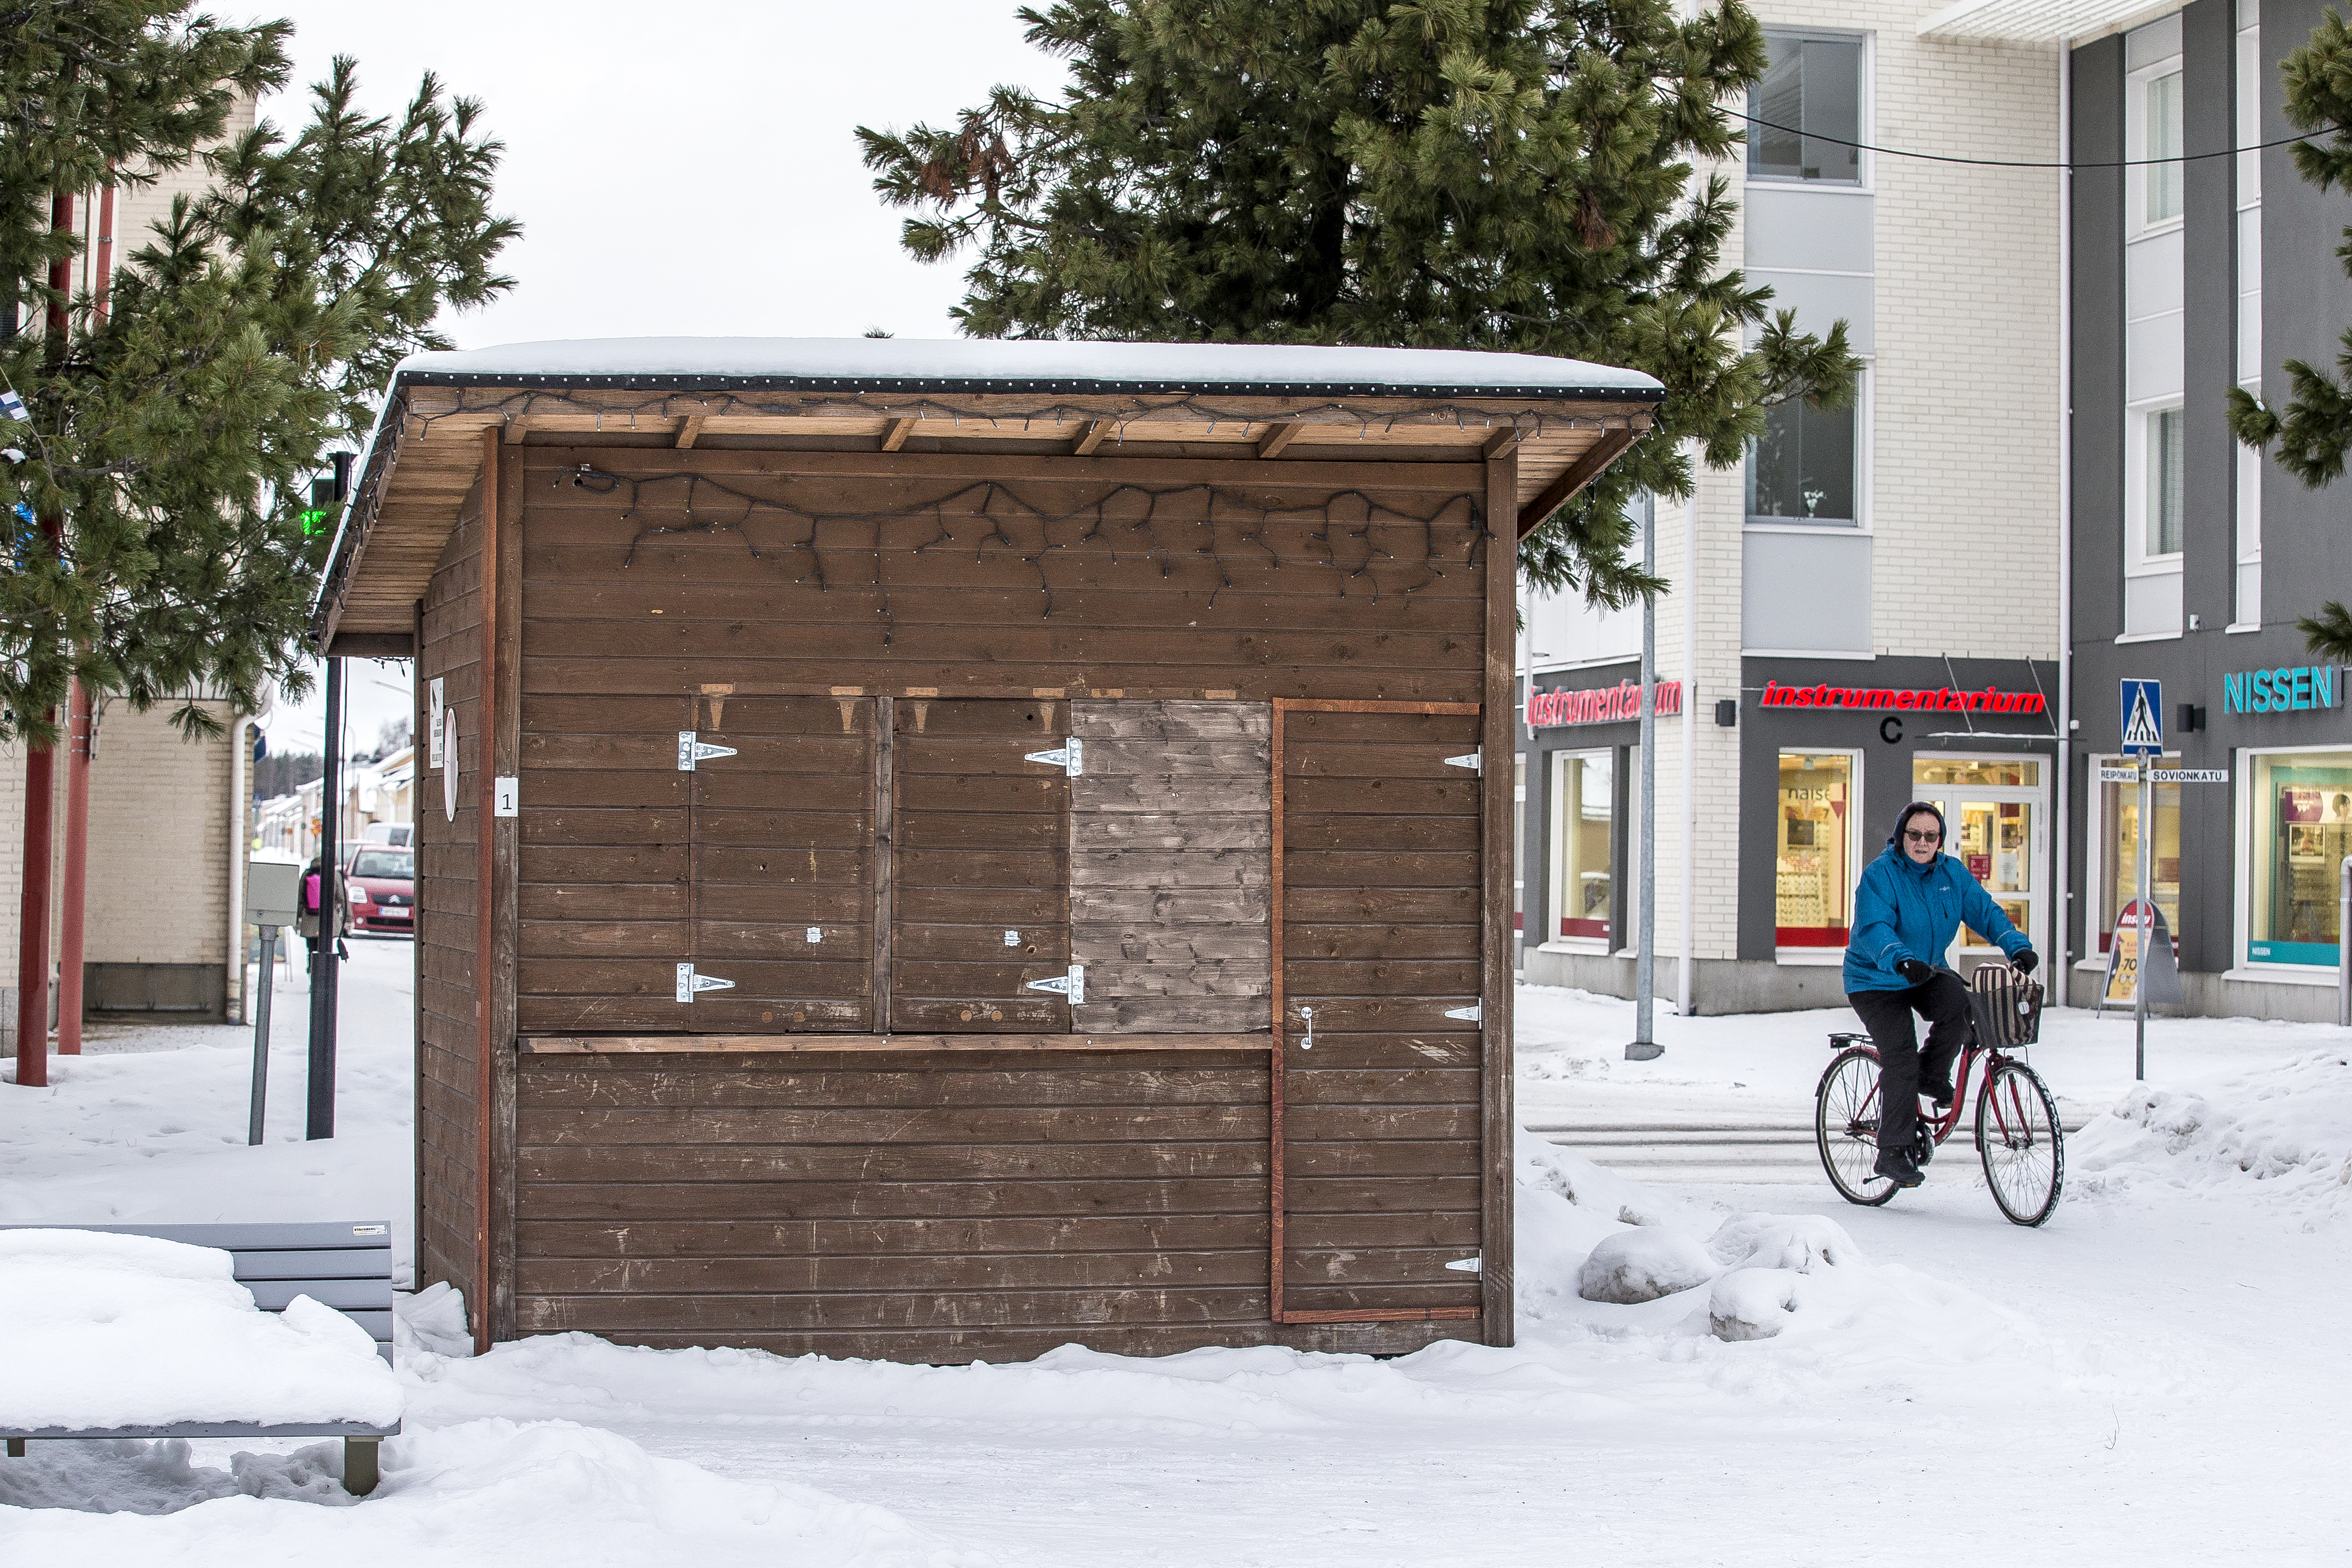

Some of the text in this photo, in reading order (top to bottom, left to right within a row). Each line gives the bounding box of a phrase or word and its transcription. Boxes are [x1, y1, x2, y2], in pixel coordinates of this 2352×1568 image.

[1762, 680, 2045, 713] instrumentarium
[2224, 665, 2332, 714] NISSEN
[1880, 716, 1903, 744] C
[2153, 771, 2222, 780] SOVIONKATU
[502, 793, 512, 810] 1
